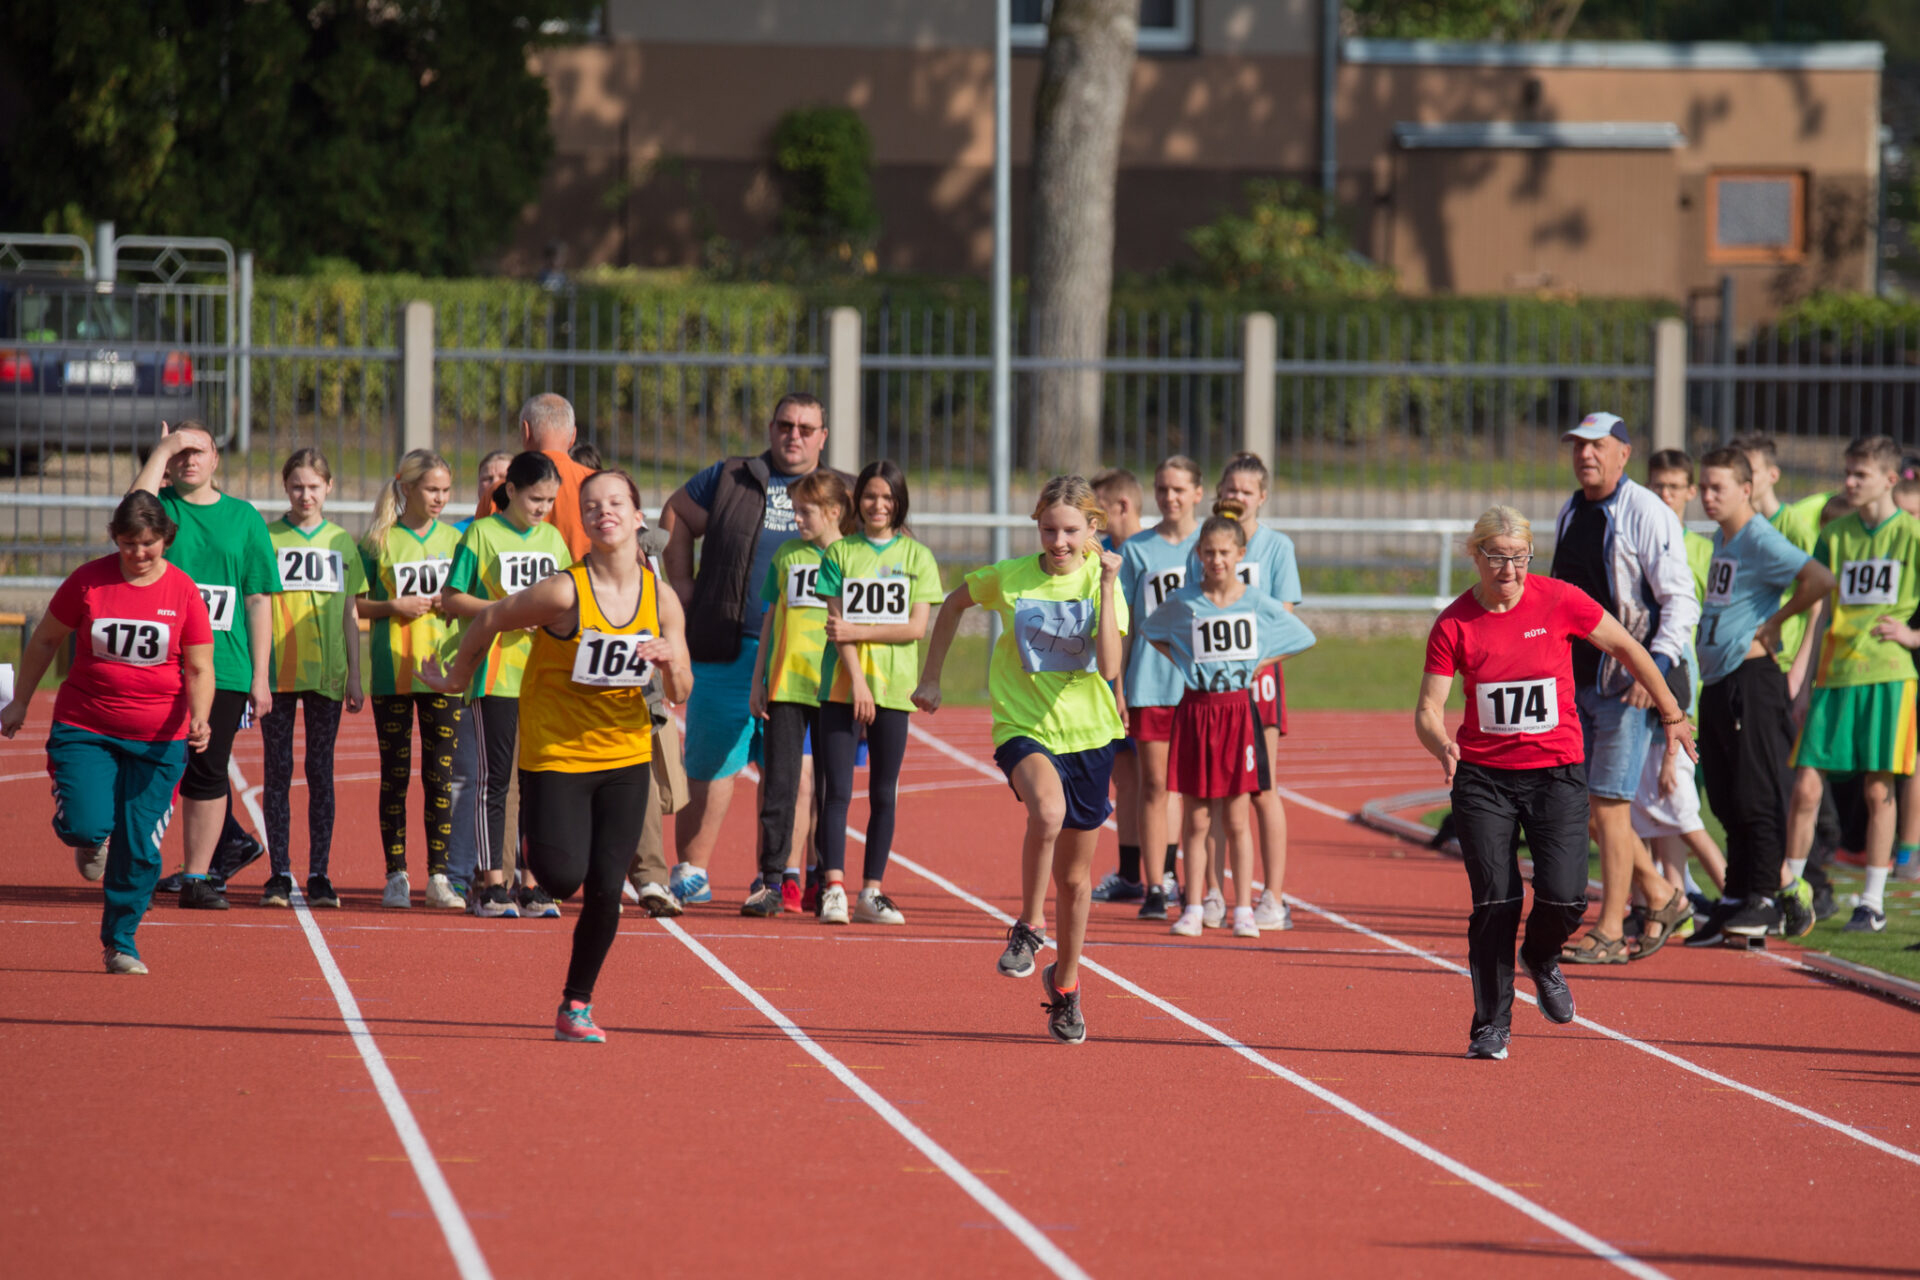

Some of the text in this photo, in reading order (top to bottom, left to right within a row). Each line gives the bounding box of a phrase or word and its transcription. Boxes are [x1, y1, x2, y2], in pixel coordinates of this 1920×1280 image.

[284, 551, 338, 582] 201
[1846, 565, 1892, 595] 194
[794, 569, 818, 598] 19
[846, 582, 905, 615] 203
[1149, 573, 1181, 606] 18
[102, 623, 160, 660] 173
[1197, 618, 1252, 653] 190
[587, 638, 648, 678] 164
[1487, 684, 1548, 725] 174
